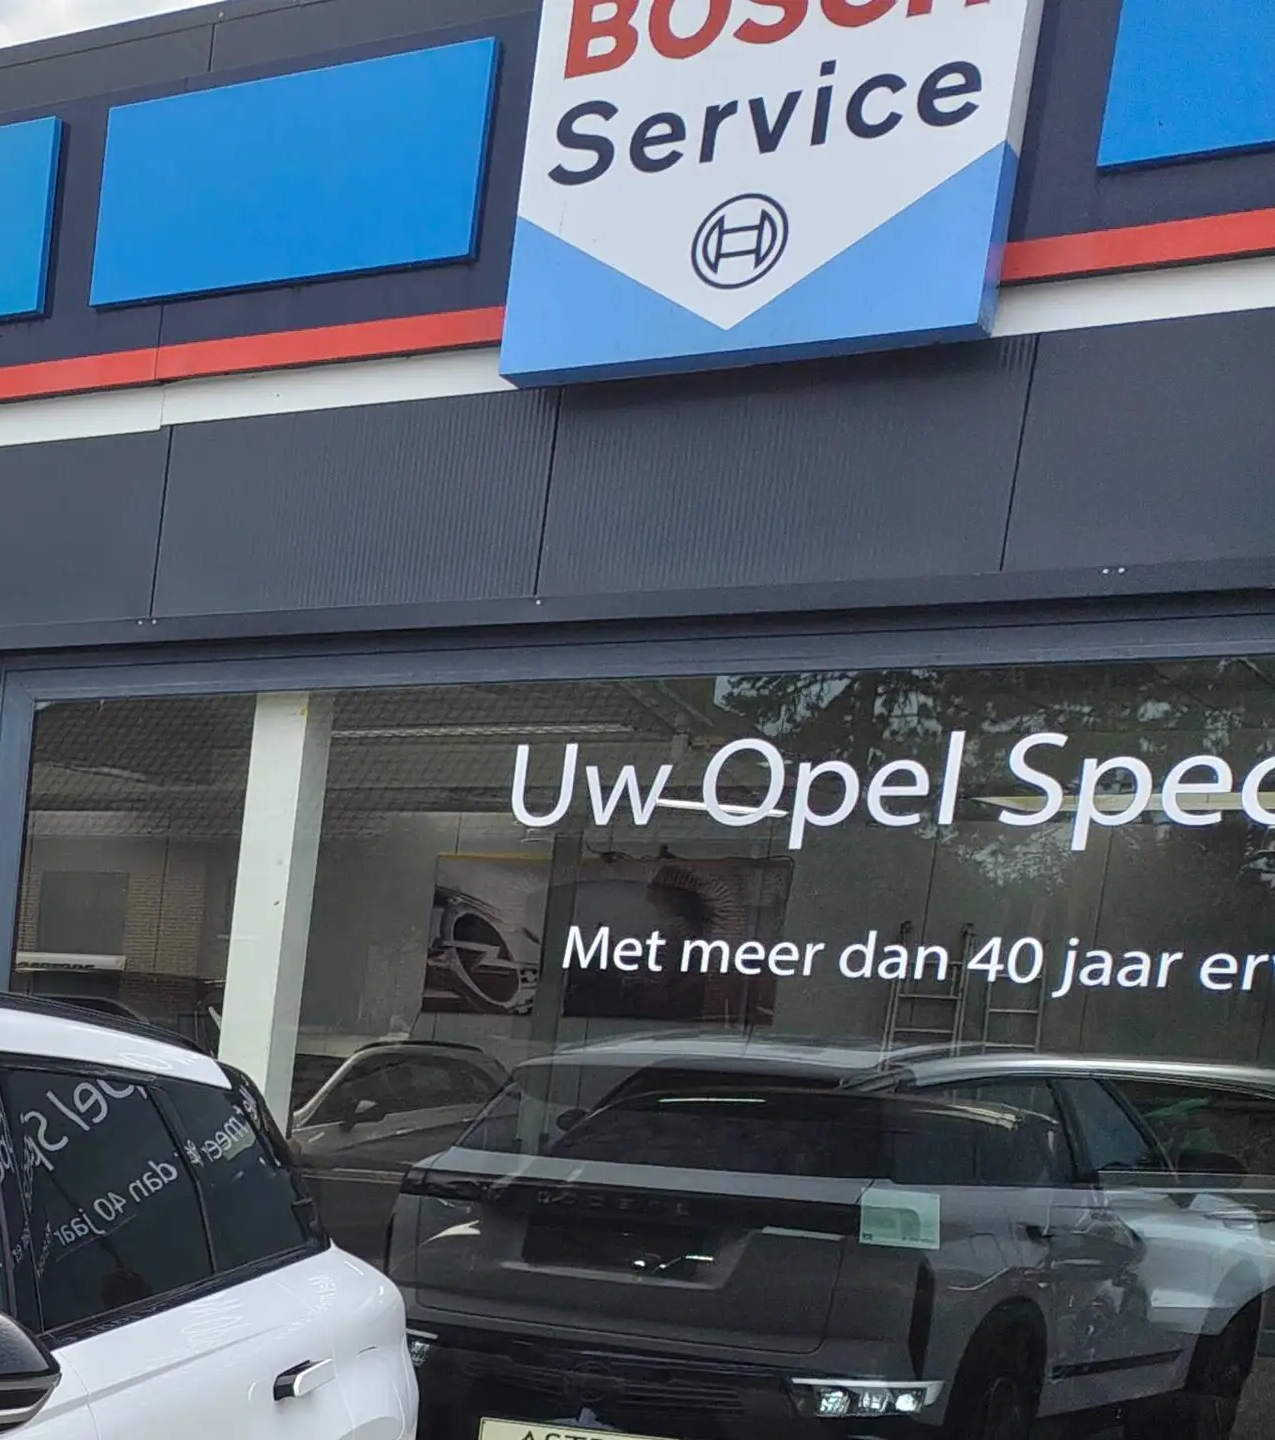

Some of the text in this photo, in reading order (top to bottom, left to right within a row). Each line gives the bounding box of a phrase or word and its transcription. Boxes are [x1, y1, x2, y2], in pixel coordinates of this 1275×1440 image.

[564, 0, 991, 79] BOS
[547, 60, 982, 186] Service
[511, 742, 674, 828] Uw
[702, 730, 966, 850] Opel
[562, 925, 1275, 998] Met meer dan 40 jaar er
